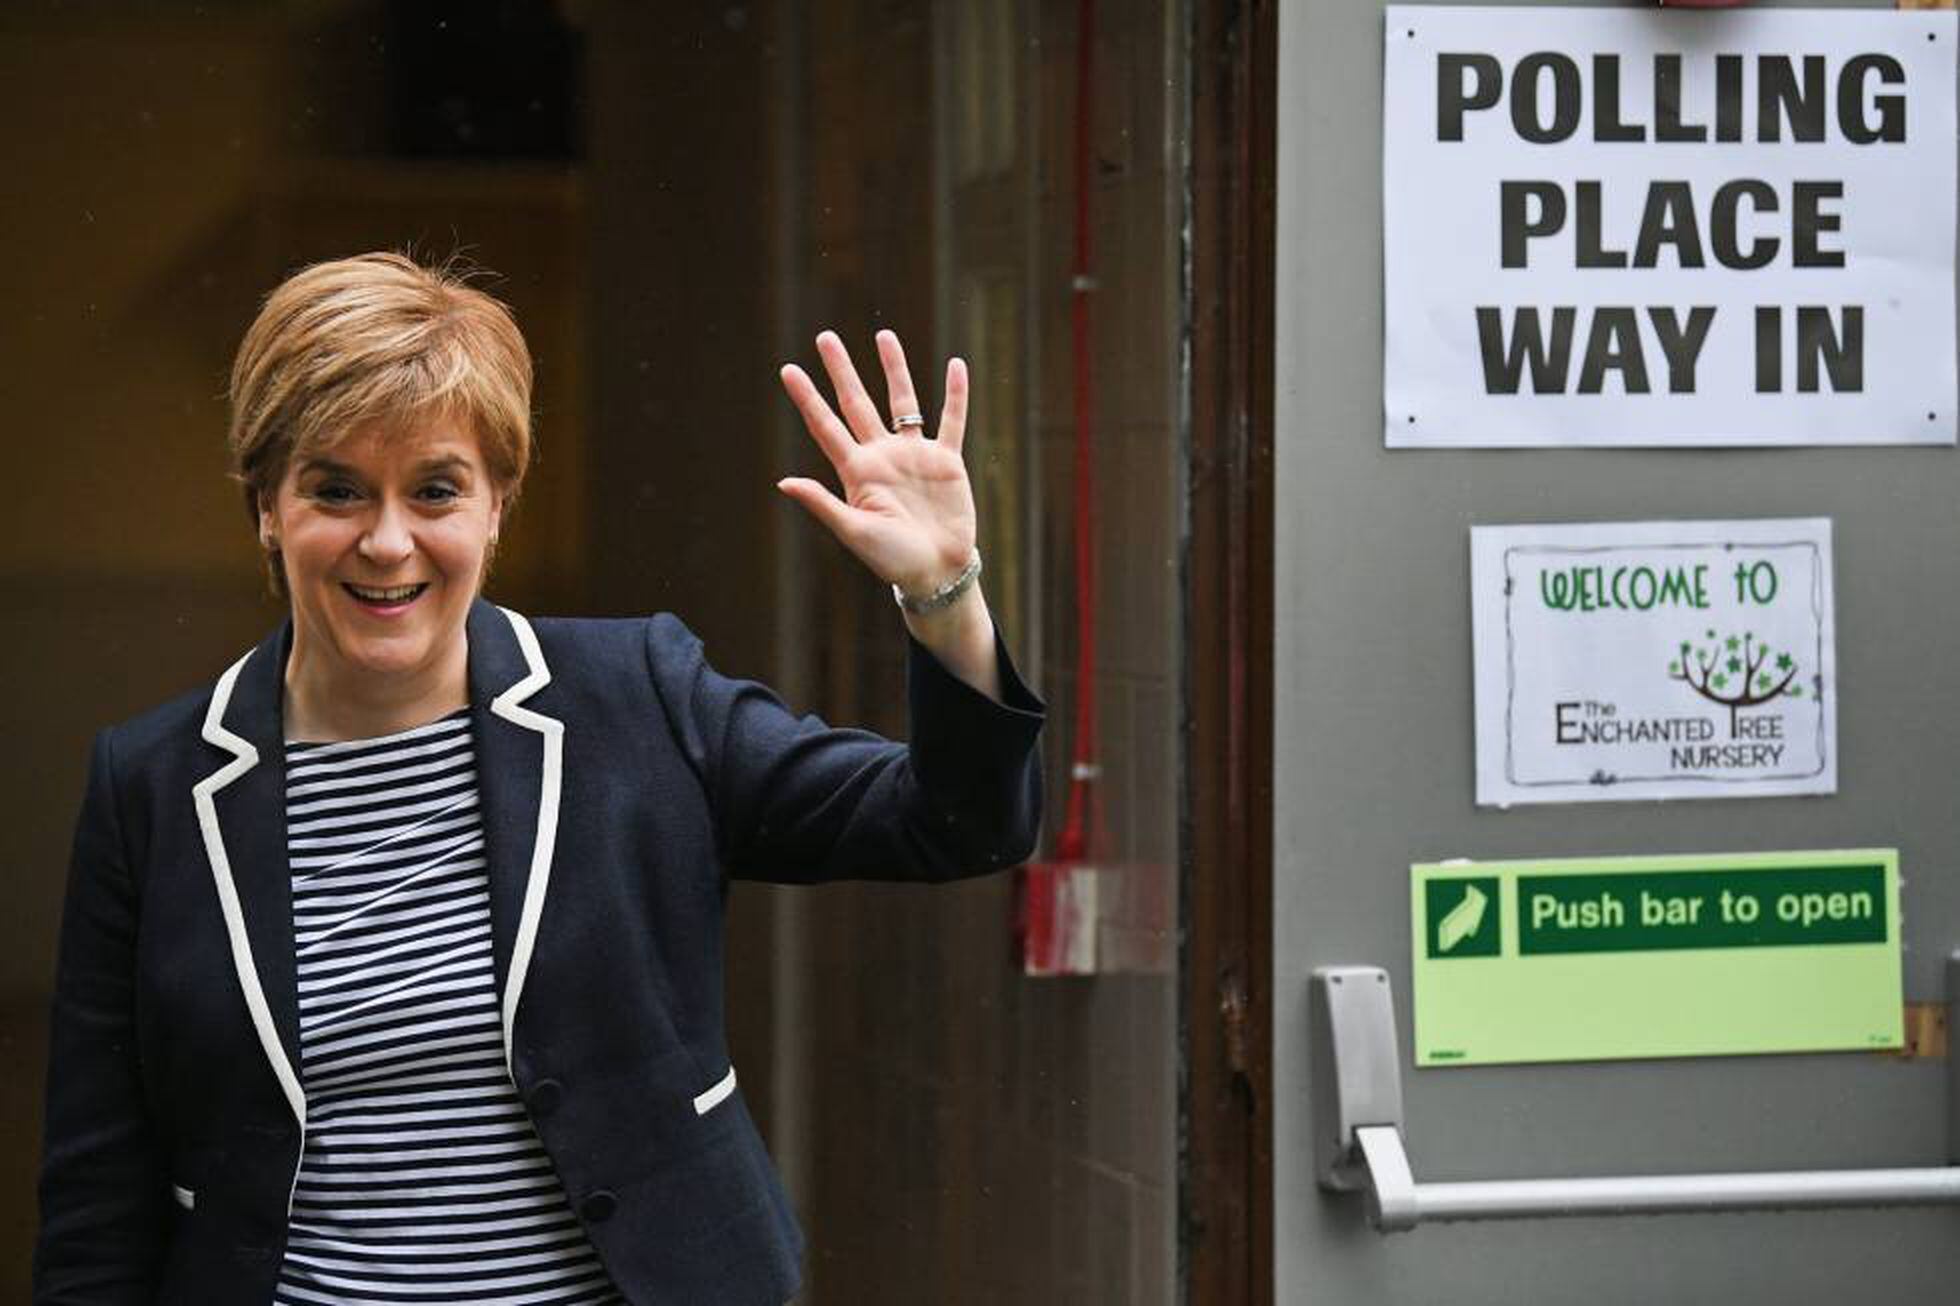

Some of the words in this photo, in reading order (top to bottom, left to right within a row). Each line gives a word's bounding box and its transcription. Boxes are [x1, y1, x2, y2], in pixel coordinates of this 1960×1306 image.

[1437, 51, 1906, 145] POLLING
[1501, 179, 1845, 271] PLACE
[1475, 306, 1717, 395] WAY
[1755, 306, 1864, 393] IN
[1541, 565, 1710, 612] WELCOME
[1556, 702, 1714, 744] ENCHANTED
[1585, 701, 1616, 716] The
[1671, 744, 1784, 769] NURSERY
[1532, 893, 1624, 929] Push
[1641, 890, 1702, 926] bar
[1721, 890, 1759, 923] to
[1777, 890, 1872, 927] open
